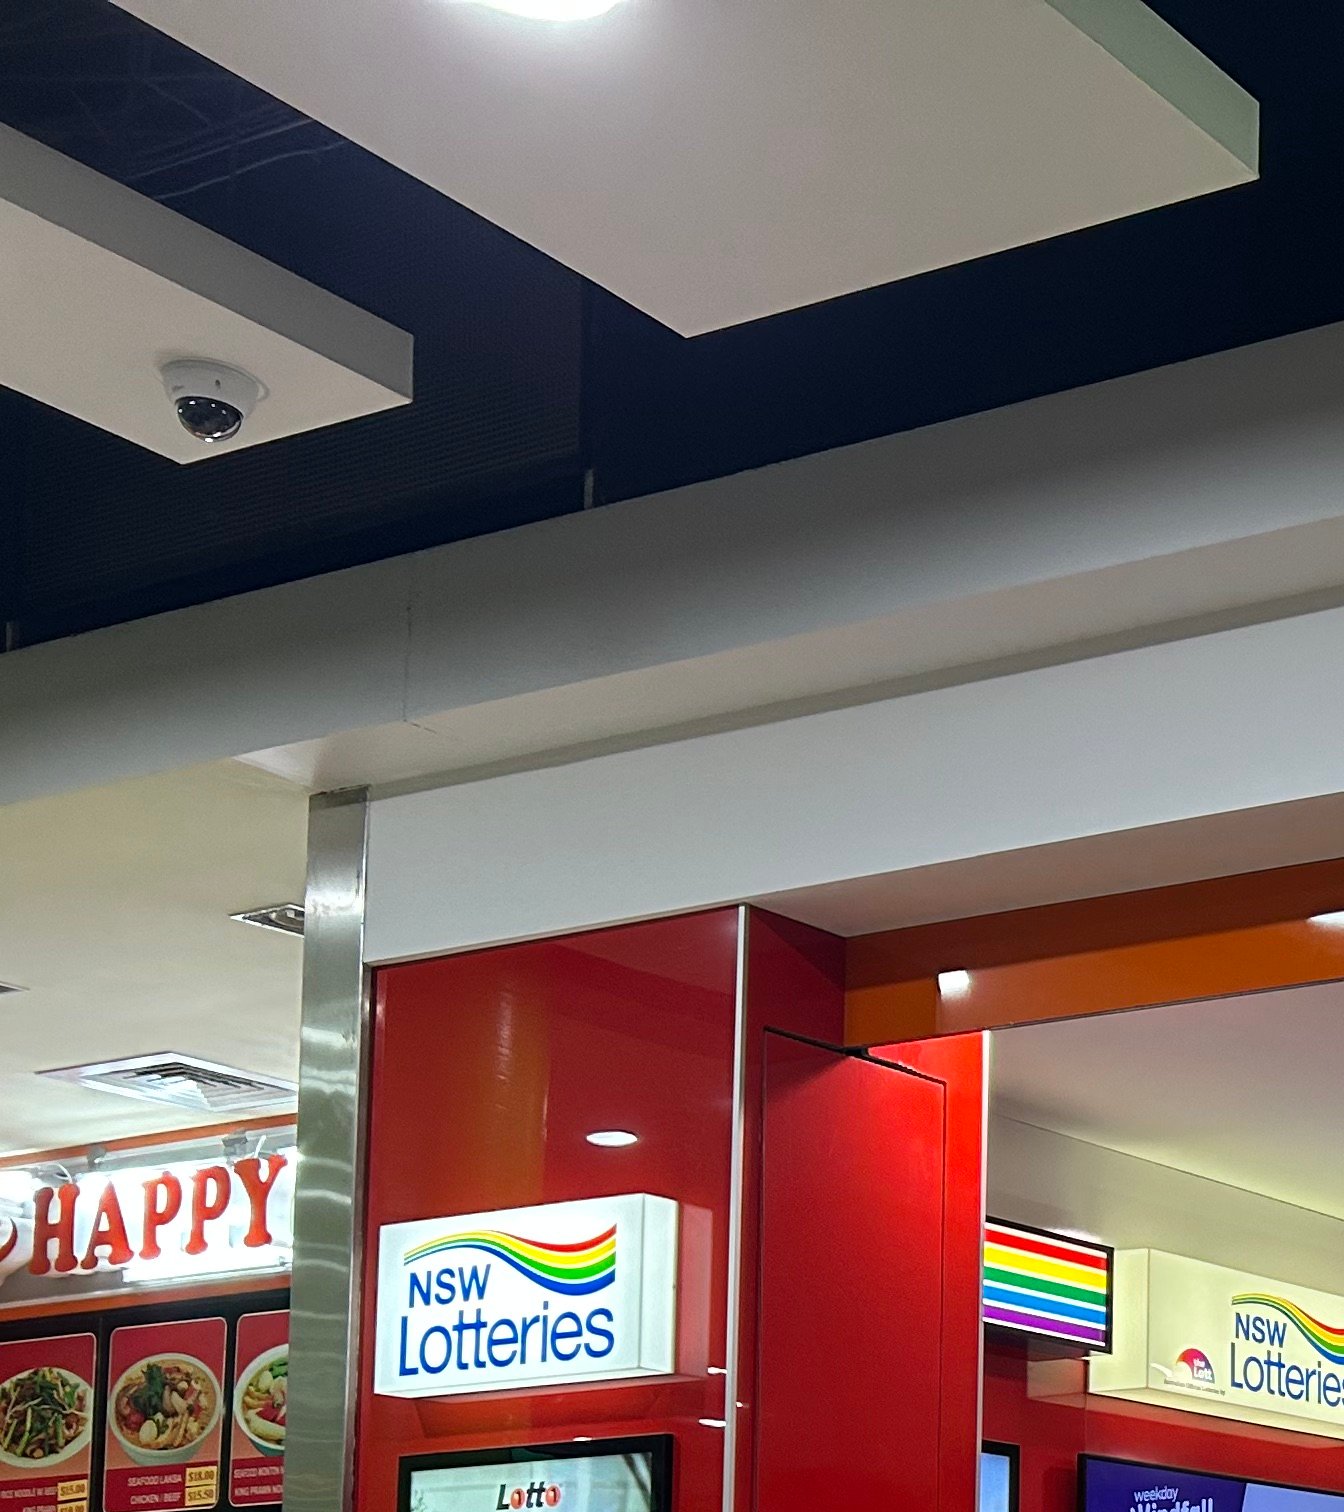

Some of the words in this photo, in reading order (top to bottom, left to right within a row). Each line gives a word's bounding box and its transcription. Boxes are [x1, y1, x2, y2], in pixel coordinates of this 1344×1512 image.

[30, 1154, 287, 1275] HAPPY
[409, 1263, 490, 1307] NSW
[399, 1301, 614, 1376] Lotteries
[1236, 1312, 1287, 1347] NSW
[1193, 1367, 1212, 1381] Lott
[496, 1481, 562, 1510] Lotto
[1134, 1486, 1179, 1502] weekday
